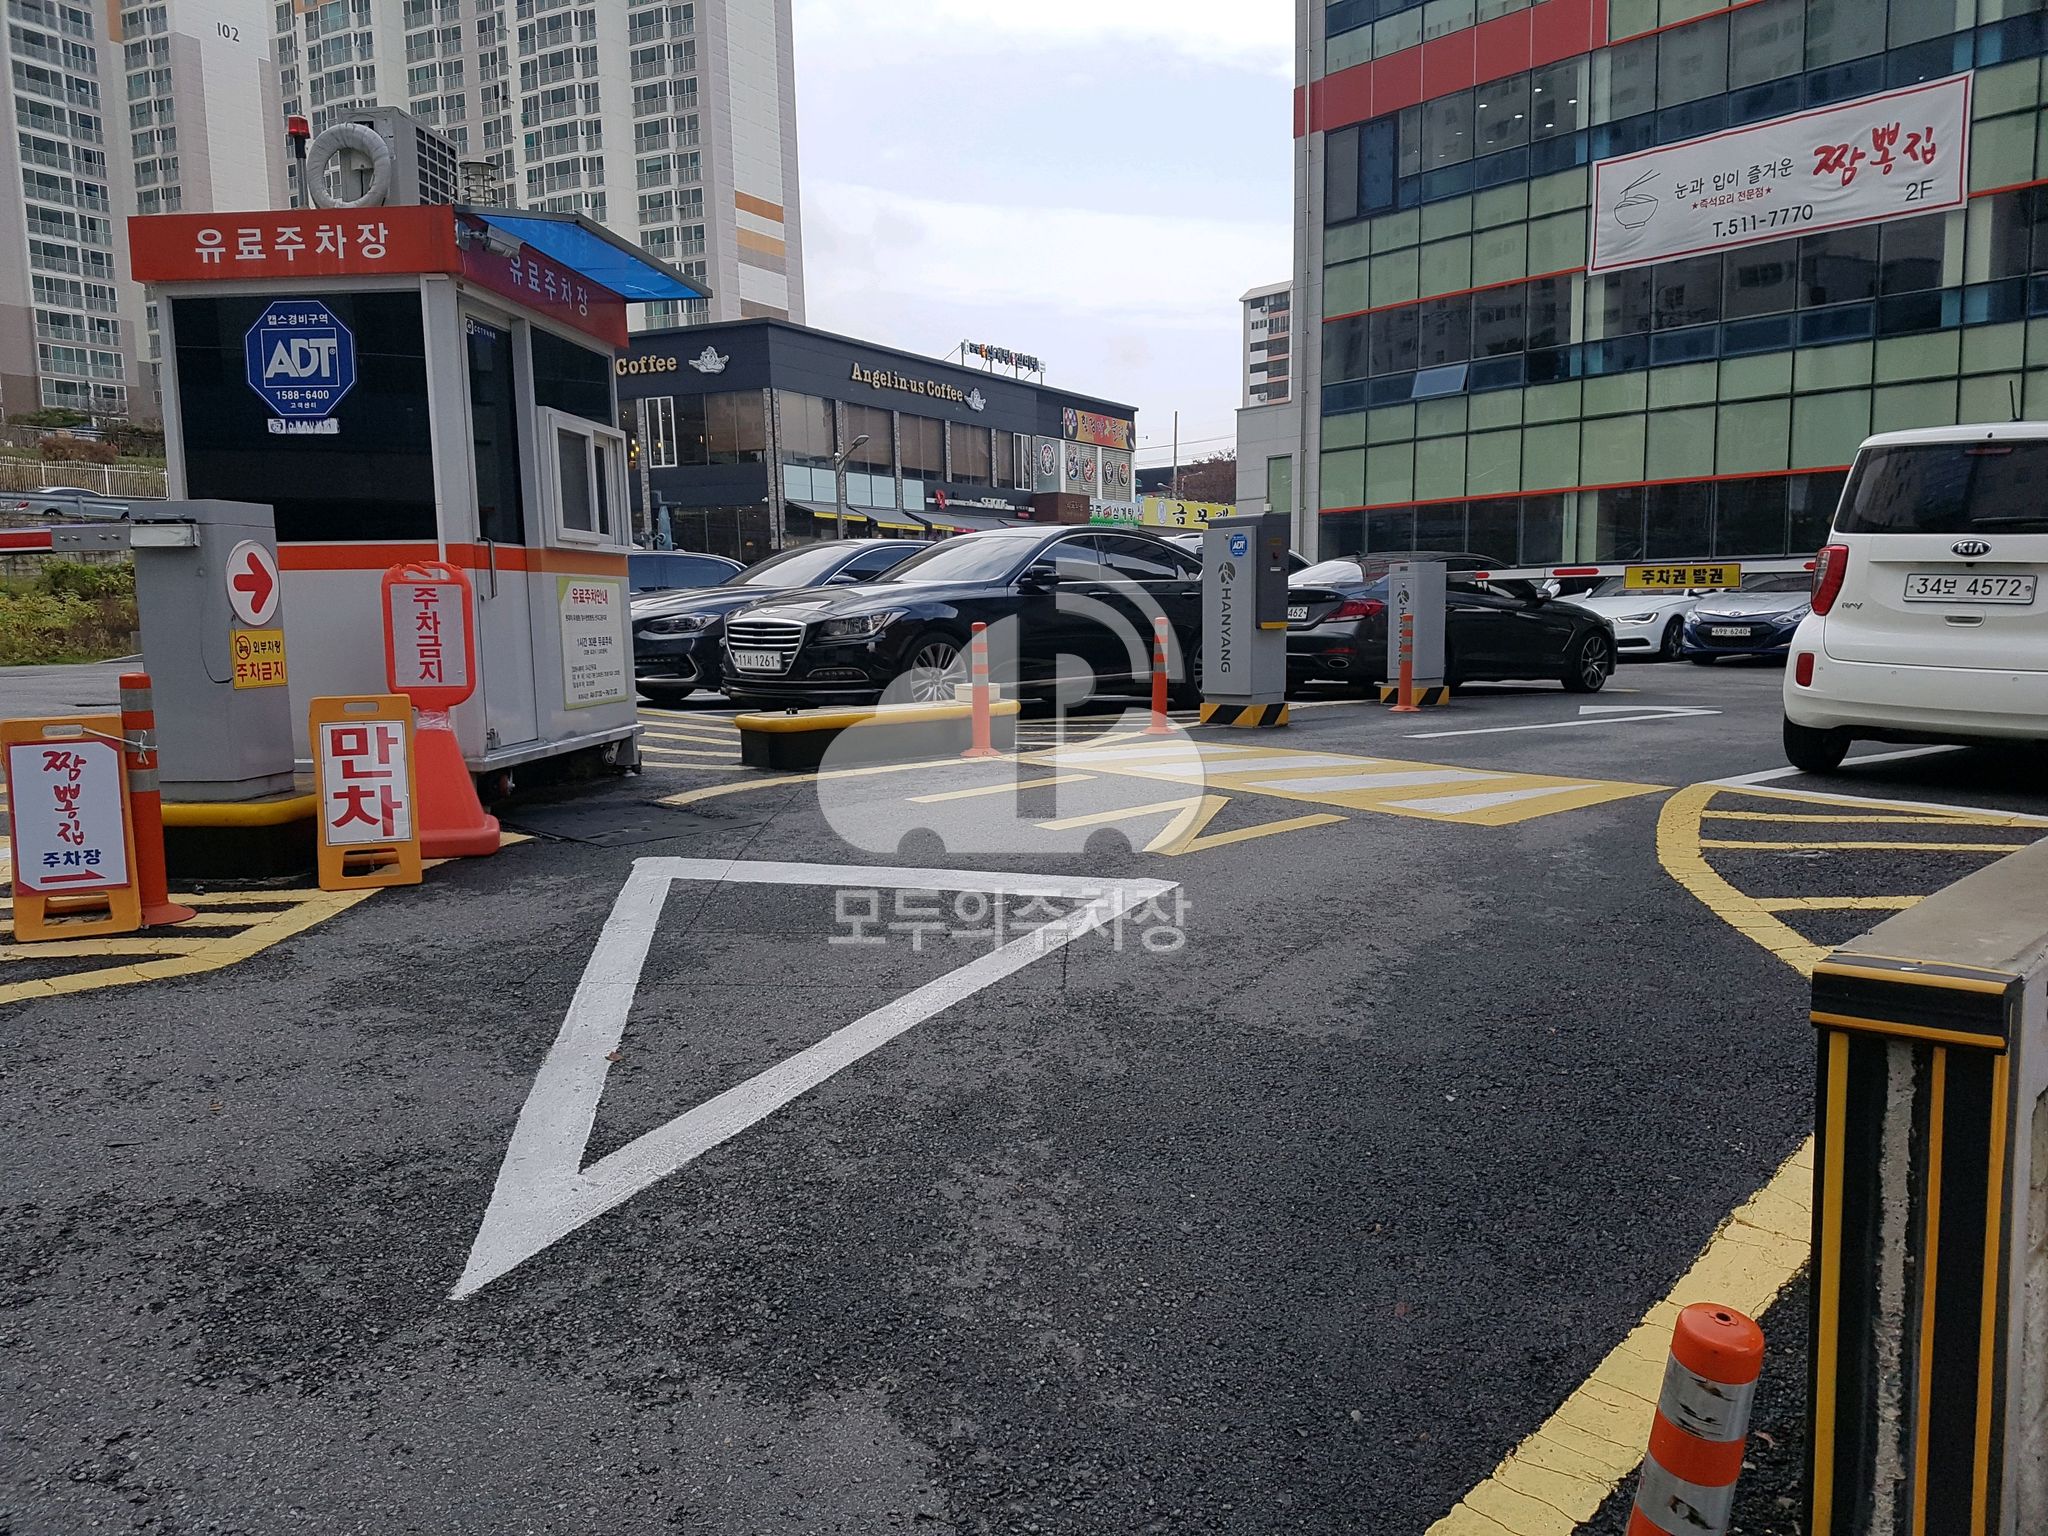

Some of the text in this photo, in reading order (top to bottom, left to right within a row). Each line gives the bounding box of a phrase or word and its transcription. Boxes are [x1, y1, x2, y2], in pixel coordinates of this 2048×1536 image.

[217, 22, 240, 43] 102
[1812, 121, 1937, 187] 짬뽕집
[1674, 157, 1794, 200] 눈과 입이 즐거운
[1737, 186, 1764, 203] 전문점
[1904, 179, 1935, 202] 2F
[1712, 204, 1814, 238] T.511-7770
[195, 222, 389, 264] 유료주차장
[509, 255, 588, 317] 유료주차장
[265, 338, 337, 378] ADT
[615, 354, 677, 376] Coffee
[276, 390, 330, 400] 1588-6400
[926, 380, 963, 402] Coffee
[1232, 540, 1245, 550] ADT
[1641, 568, 1723, 585] 주차권 발권
[1916, 577, 2022, 597] 34보 4572
[413, 587, 443, 683] 주차금지
[1220, 587, 1232, 673] HANYANG
[252, 640, 281, 654] 외부차량
[236, 660, 284, 683] 주차금지
[755, 654, 775, 667] 1261
[330, 726, 403, 837] 만차
[42, 751, 87, 846] 짬뽕집
[42, 848, 102, 868] 주차장
